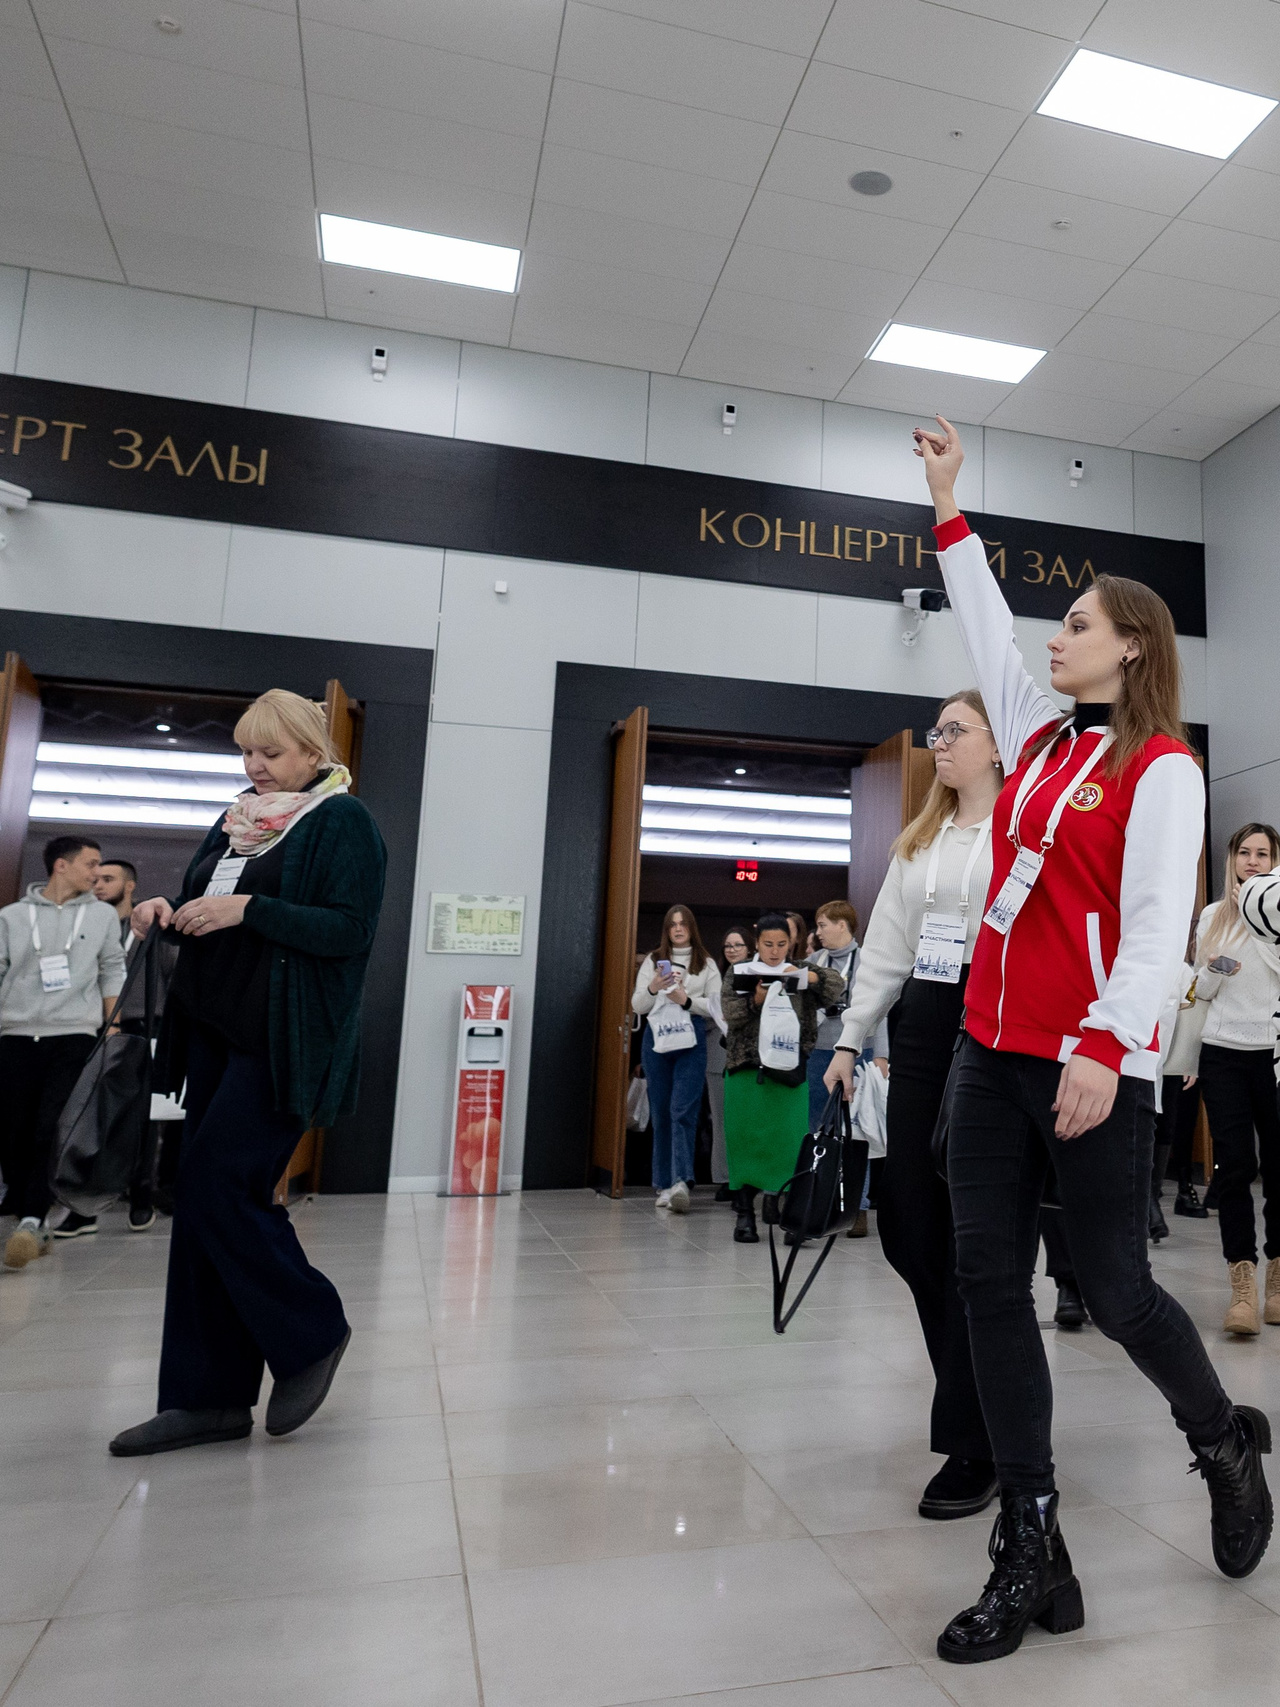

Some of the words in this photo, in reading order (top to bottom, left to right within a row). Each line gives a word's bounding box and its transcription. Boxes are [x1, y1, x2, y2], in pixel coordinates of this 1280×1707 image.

[108, 428, 268, 487] ЗАЛЫ
[699, 507, 1006, 580] КОНЦЕРТНЙ
[1022, 550, 1098, 588] ЗАЛ
[925, 935, 953, 943] УЧАСТНИК
